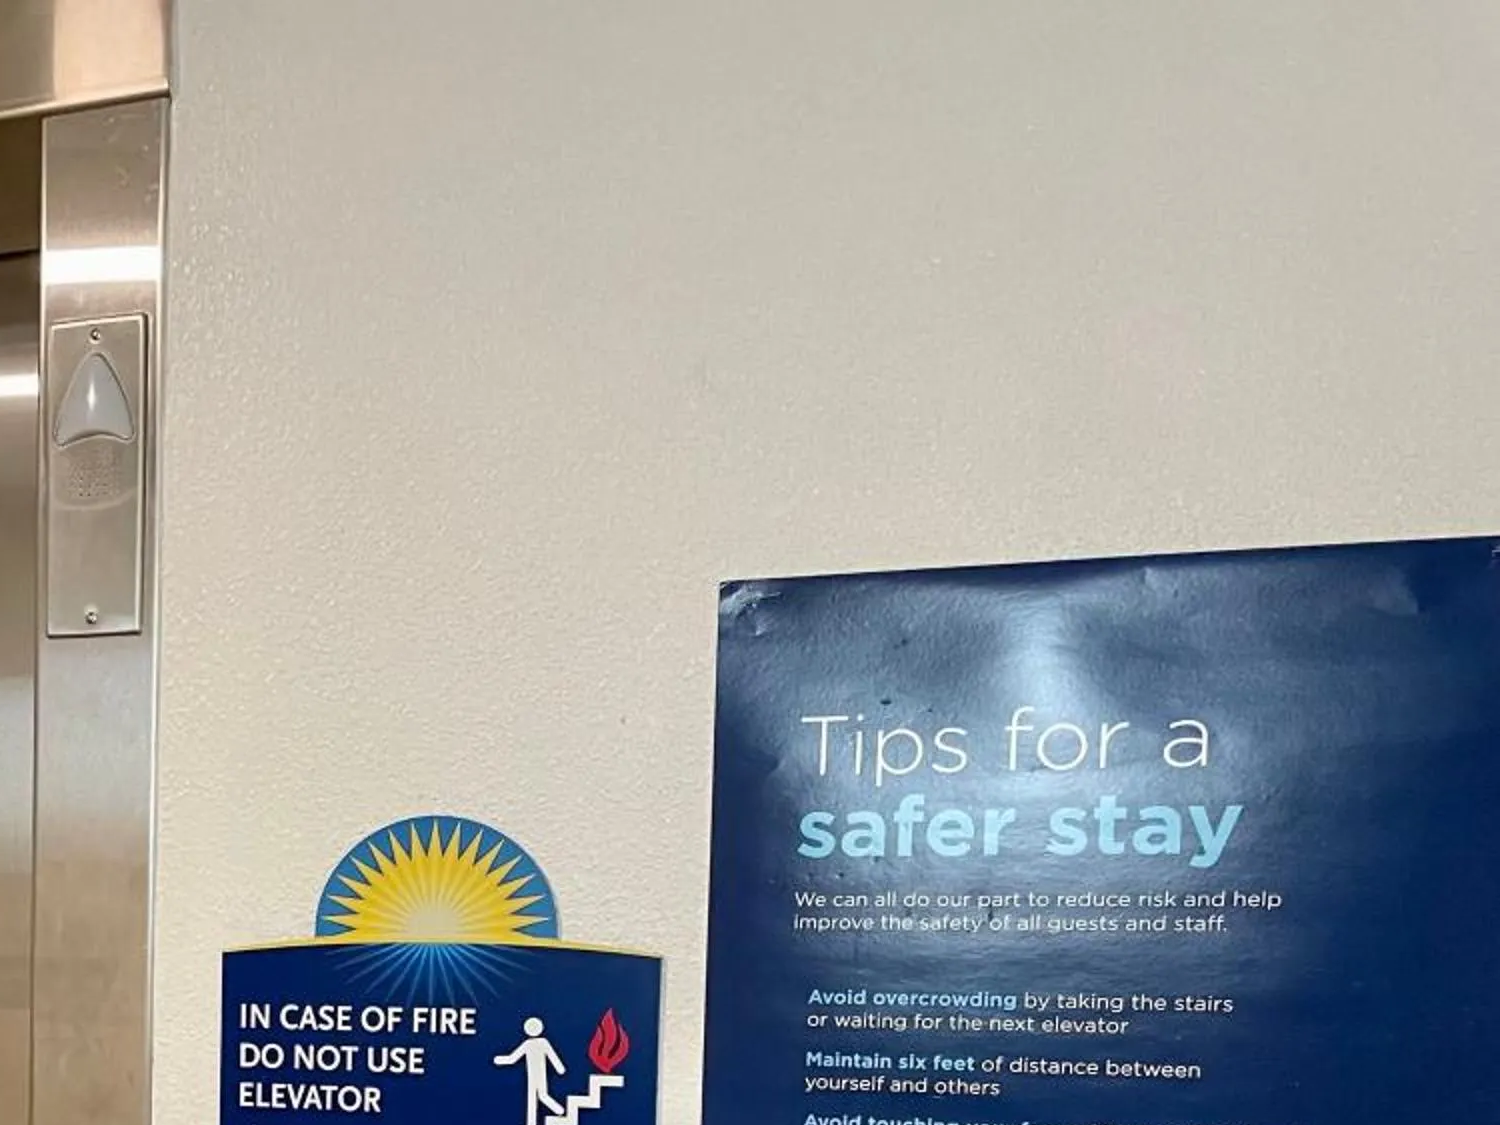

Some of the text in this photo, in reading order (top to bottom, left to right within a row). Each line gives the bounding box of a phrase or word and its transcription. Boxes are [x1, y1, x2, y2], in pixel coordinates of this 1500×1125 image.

[801, 706, 1210, 787] Tips for a
[798, 794, 1244, 868] safer stay
[795, 890, 1283, 911] We can all do our part to reduce risk and help
[794, 913, 1228, 933] improve the safety of all guests and staff.
[808, 989, 1234, 1013] Avoid overcrowding by taking the stairs
[239, 1003, 476, 1035] IN CASE OF FIRE
[807, 1012, 1129, 1034] or waiting for the next elevator
[239, 1042, 424, 1074] DO NOT USE
[805, 1051, 1201, 1079] Maintain six feet of distance between
[239, 1082, 381, 1113] ELEVATOR
[805, 1075, 1000, 1095] yourself and others
